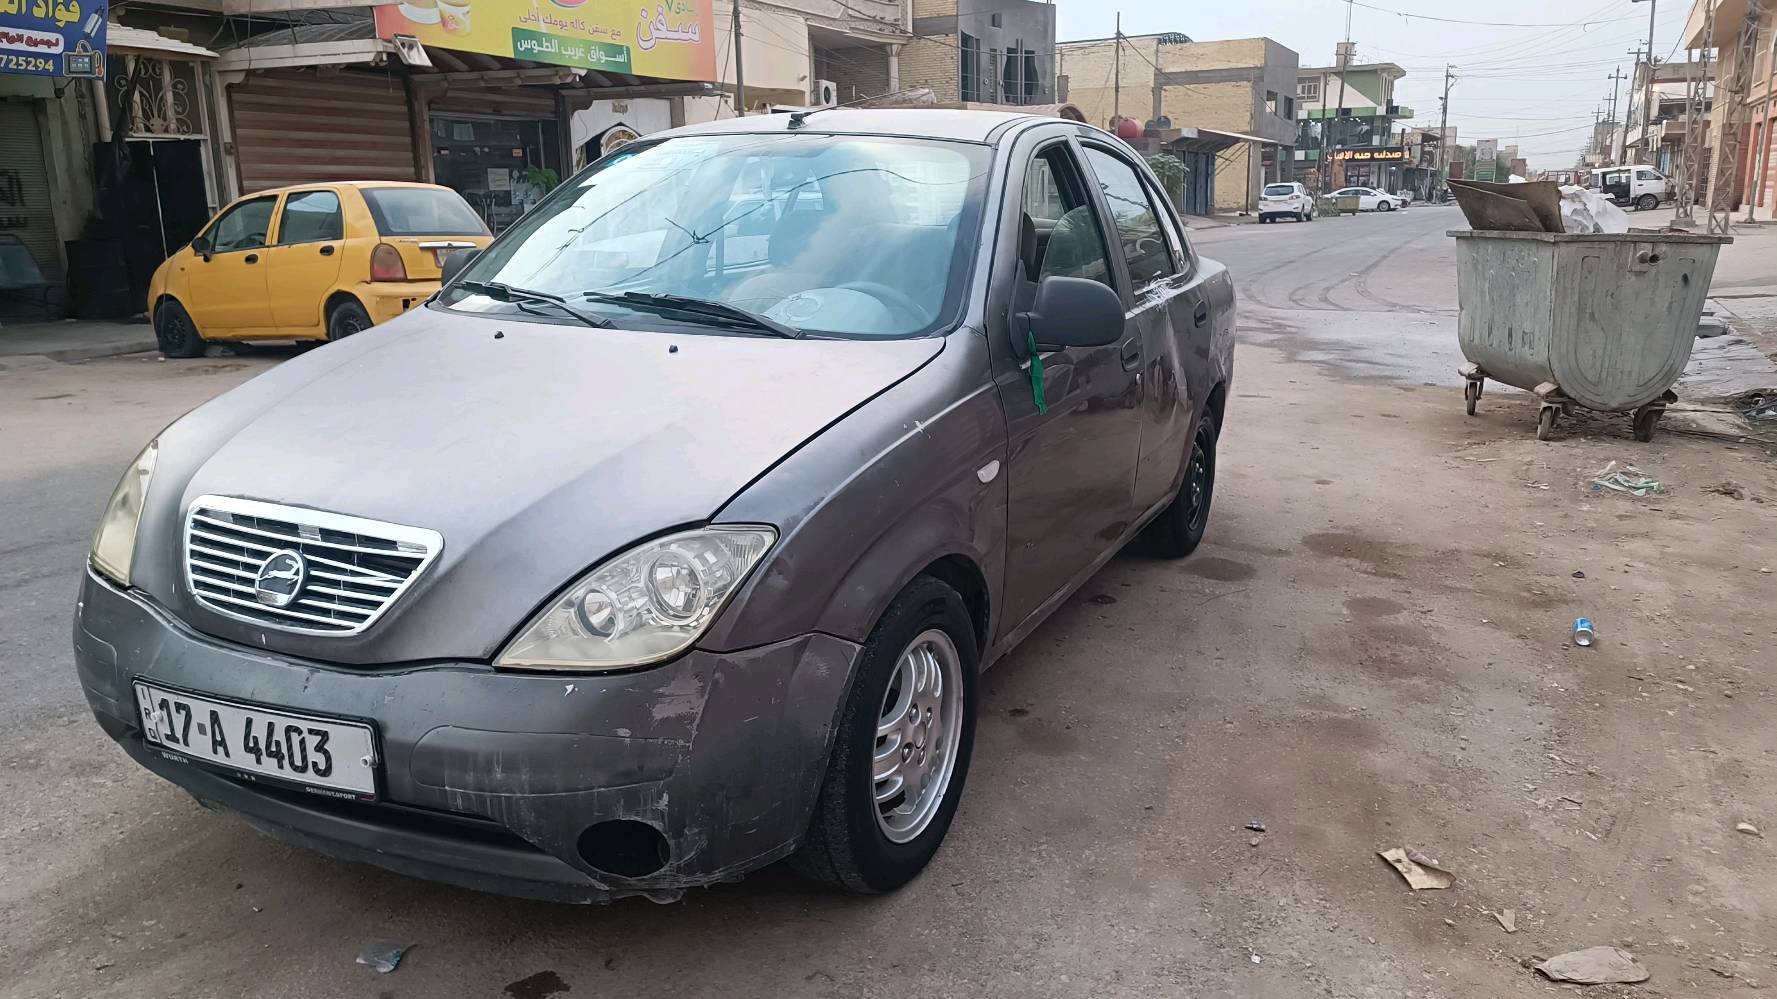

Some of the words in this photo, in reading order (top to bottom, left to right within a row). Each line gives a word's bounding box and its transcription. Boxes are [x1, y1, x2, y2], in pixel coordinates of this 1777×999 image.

[610, 29, 622, 40] مع
[636, 4, 701, 50] سفن
[25, 35, 60, 49] لجميع
[587, 45, 628, 63] أسواق
[158, 697, 192, 748] 17
[209, 709, 230, 758] A
[243, 716, 333, 778] 4403
